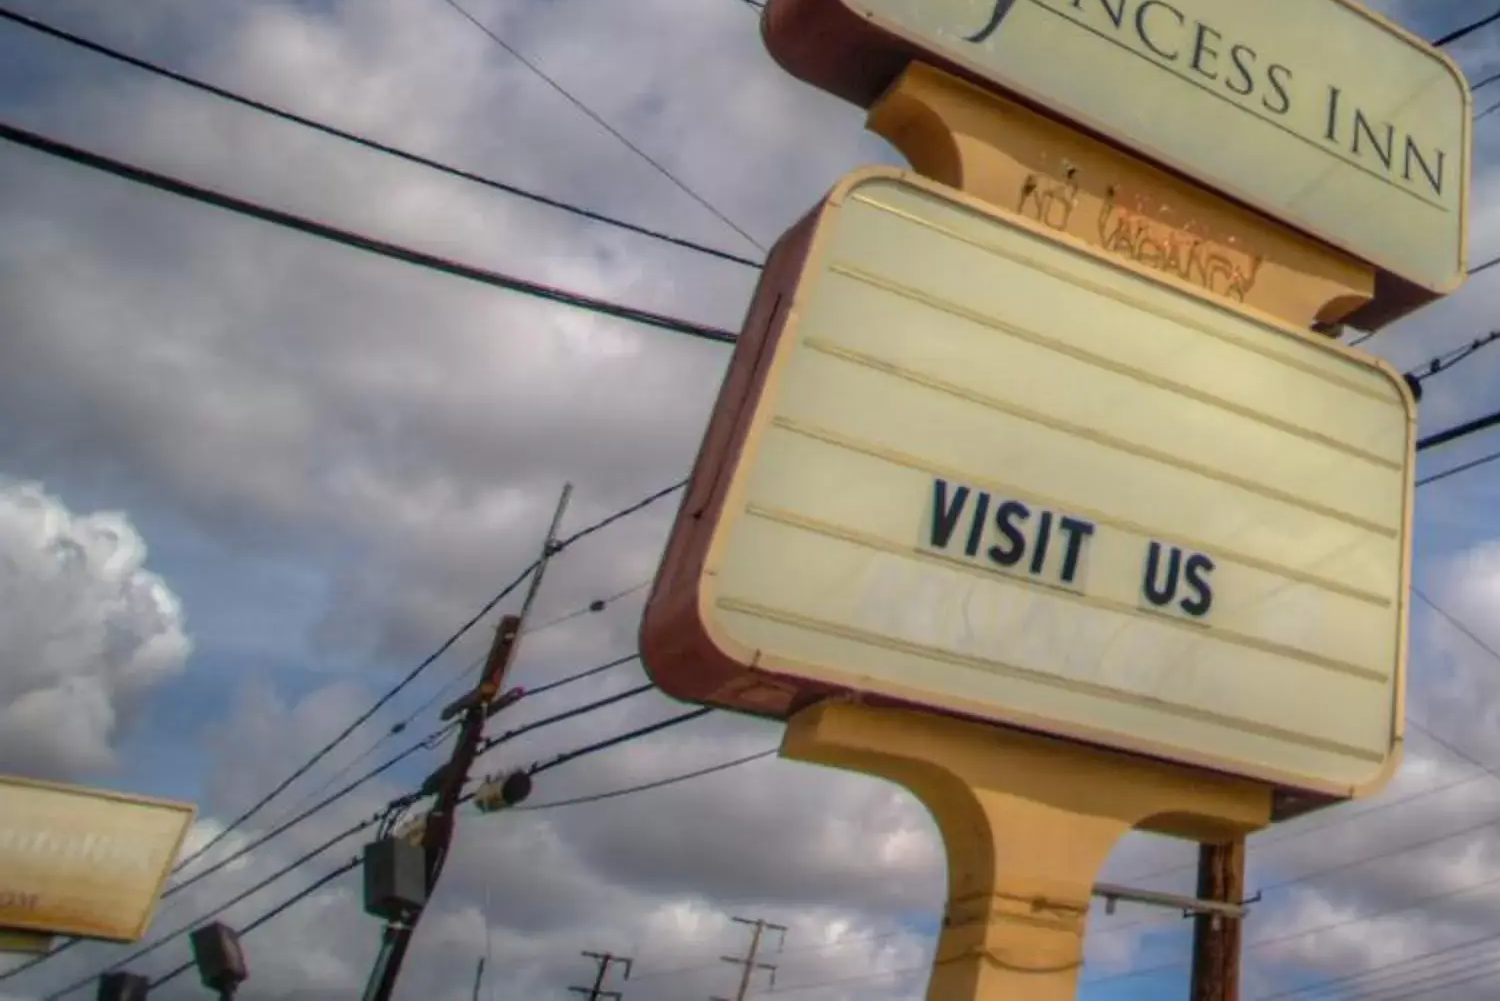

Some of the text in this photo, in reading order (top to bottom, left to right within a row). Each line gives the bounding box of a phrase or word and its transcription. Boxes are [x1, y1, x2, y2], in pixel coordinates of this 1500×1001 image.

[1324, 84, 1447, 197] INN
[1016, 173, 1078, 232] NO
[931, 478, 1216, 617] VISIT US
